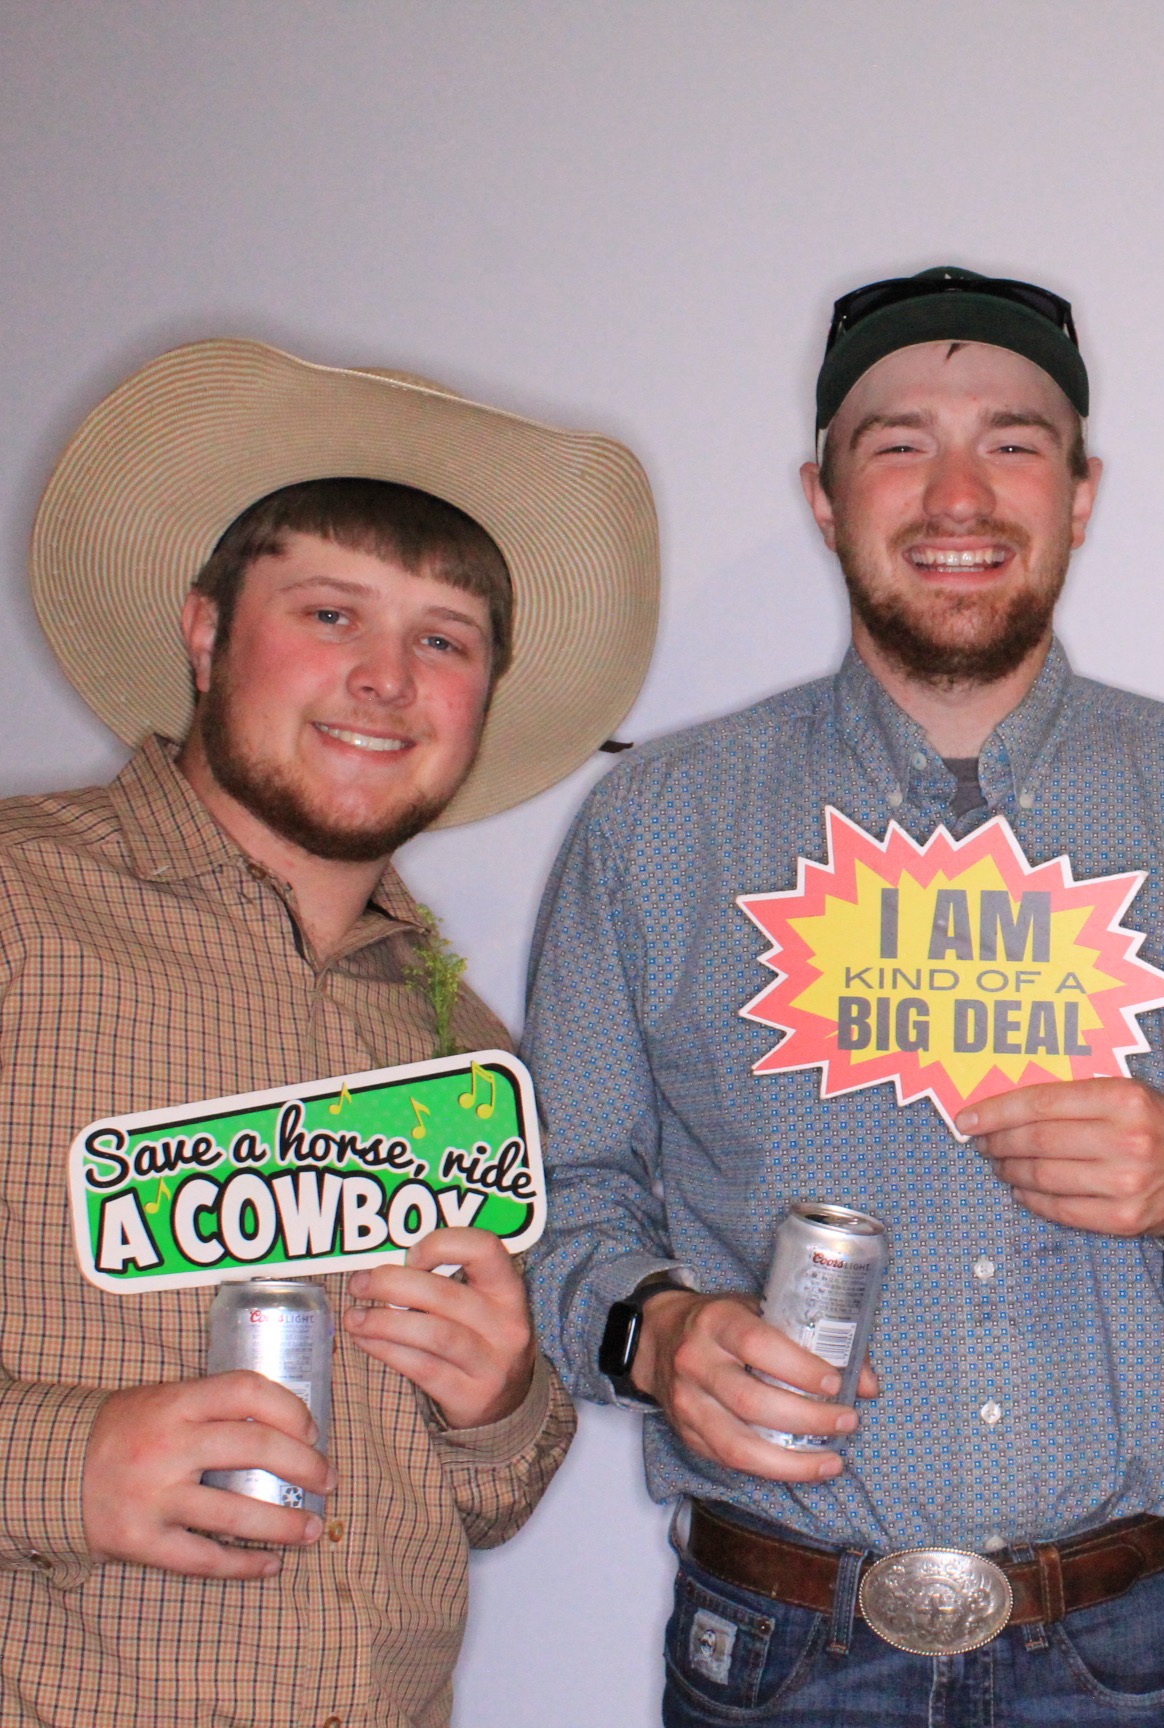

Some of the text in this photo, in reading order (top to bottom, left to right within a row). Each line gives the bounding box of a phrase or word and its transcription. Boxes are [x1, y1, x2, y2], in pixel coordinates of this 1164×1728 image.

[879, 887, 1052, 963] I AM
[844, 966, 1087, 995] KIND OF A
[836, 996, 1093, 1058] BIG DEAL
[84, 1103, 537, 1199] Save a horse, ride
[94, 1165, 489, 1274] A COWBOY
[812, 1251, 870, 1271] Coors LIGHT
[249, 1309, 315, 1324] Cos LIGHT
